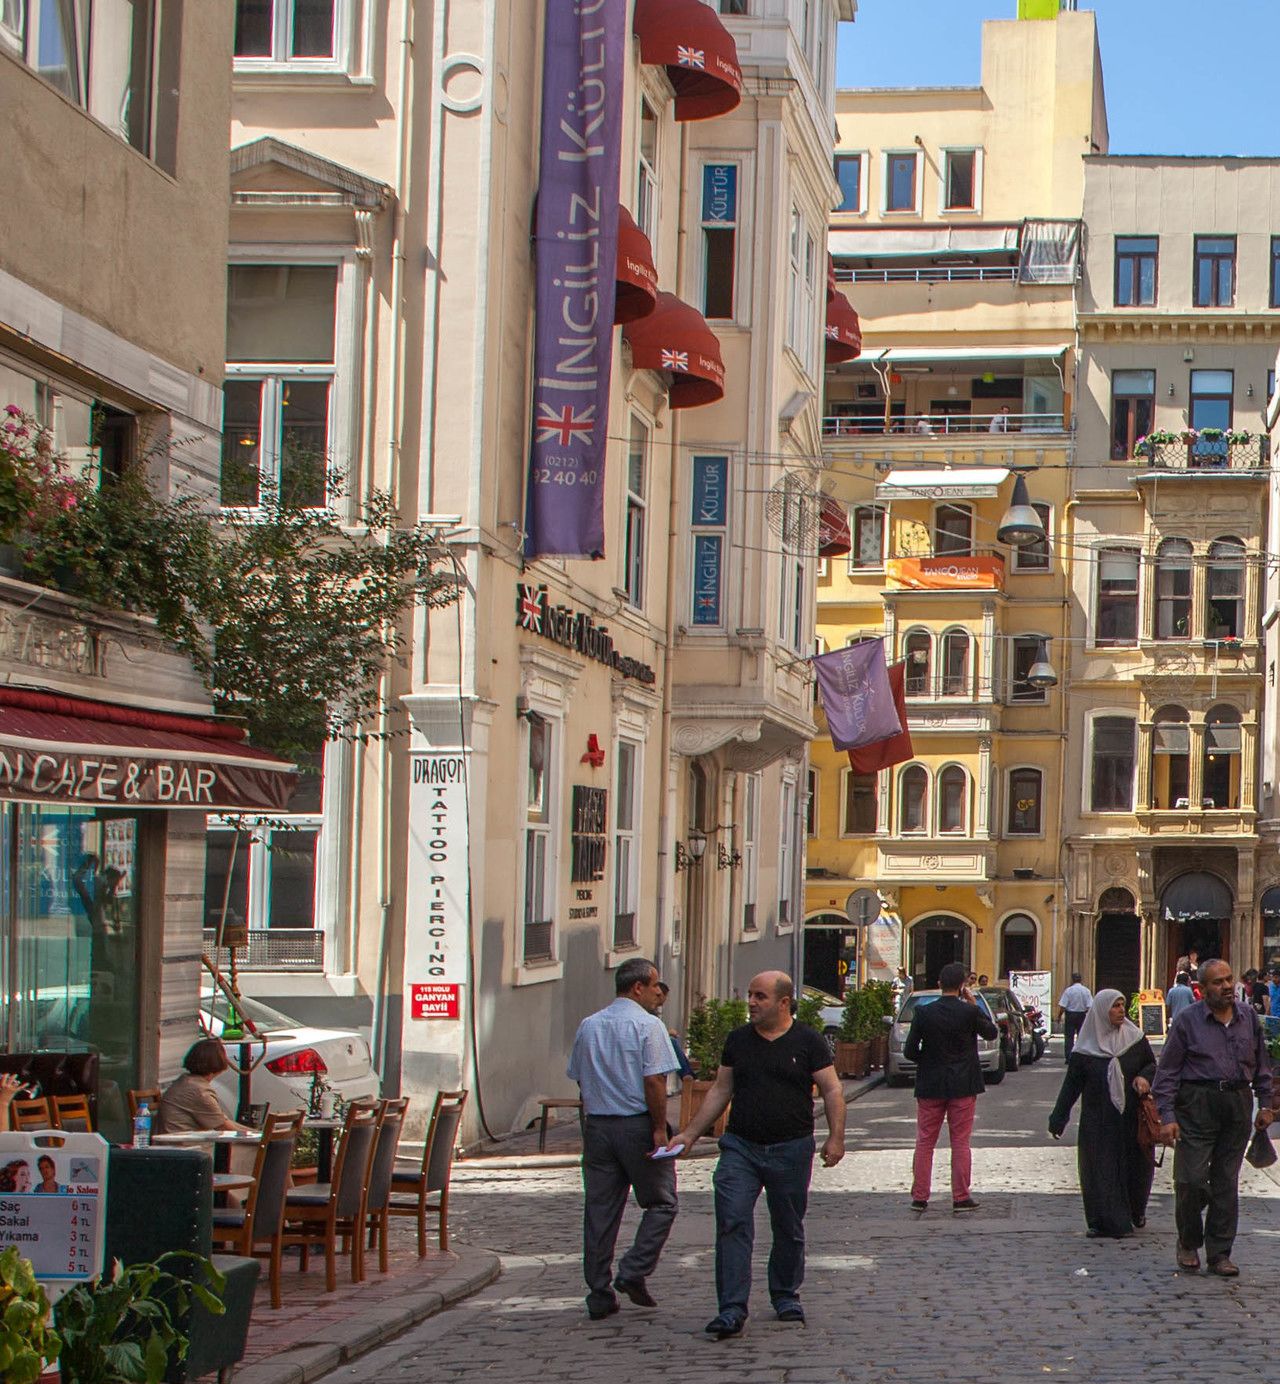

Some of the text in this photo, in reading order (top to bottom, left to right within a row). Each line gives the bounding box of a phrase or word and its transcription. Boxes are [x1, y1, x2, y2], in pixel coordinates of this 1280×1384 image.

[709, 166, 729, 222] KÜLTÜR
[545, 455, 578, 467] (0212)
[553, 471, 576, 485] 40
[580, 471, 596, 485] 40
[700, 464, 720, 521] KÜLTÜR
[695, 540, 718, 595] İNGİLİZ
[31, 754, 118, 801] CAFE
[157, 764, 217, 803] BAR
[414, 759, 464, 784] DRAGON
[429, 788, 448, 862] TATTOO
[428, 875, 445, 976] PIERCING
[415, 993, 456, 1002] GANYAN
[0, 1202, 21, 1215] Saç
[0, 1216, 30, 1227] Sakal
[70, 1216, 78, 1227] 4
[69, 1247, 76, 1258] 5
[68, 1262, 75, 1273] 5
